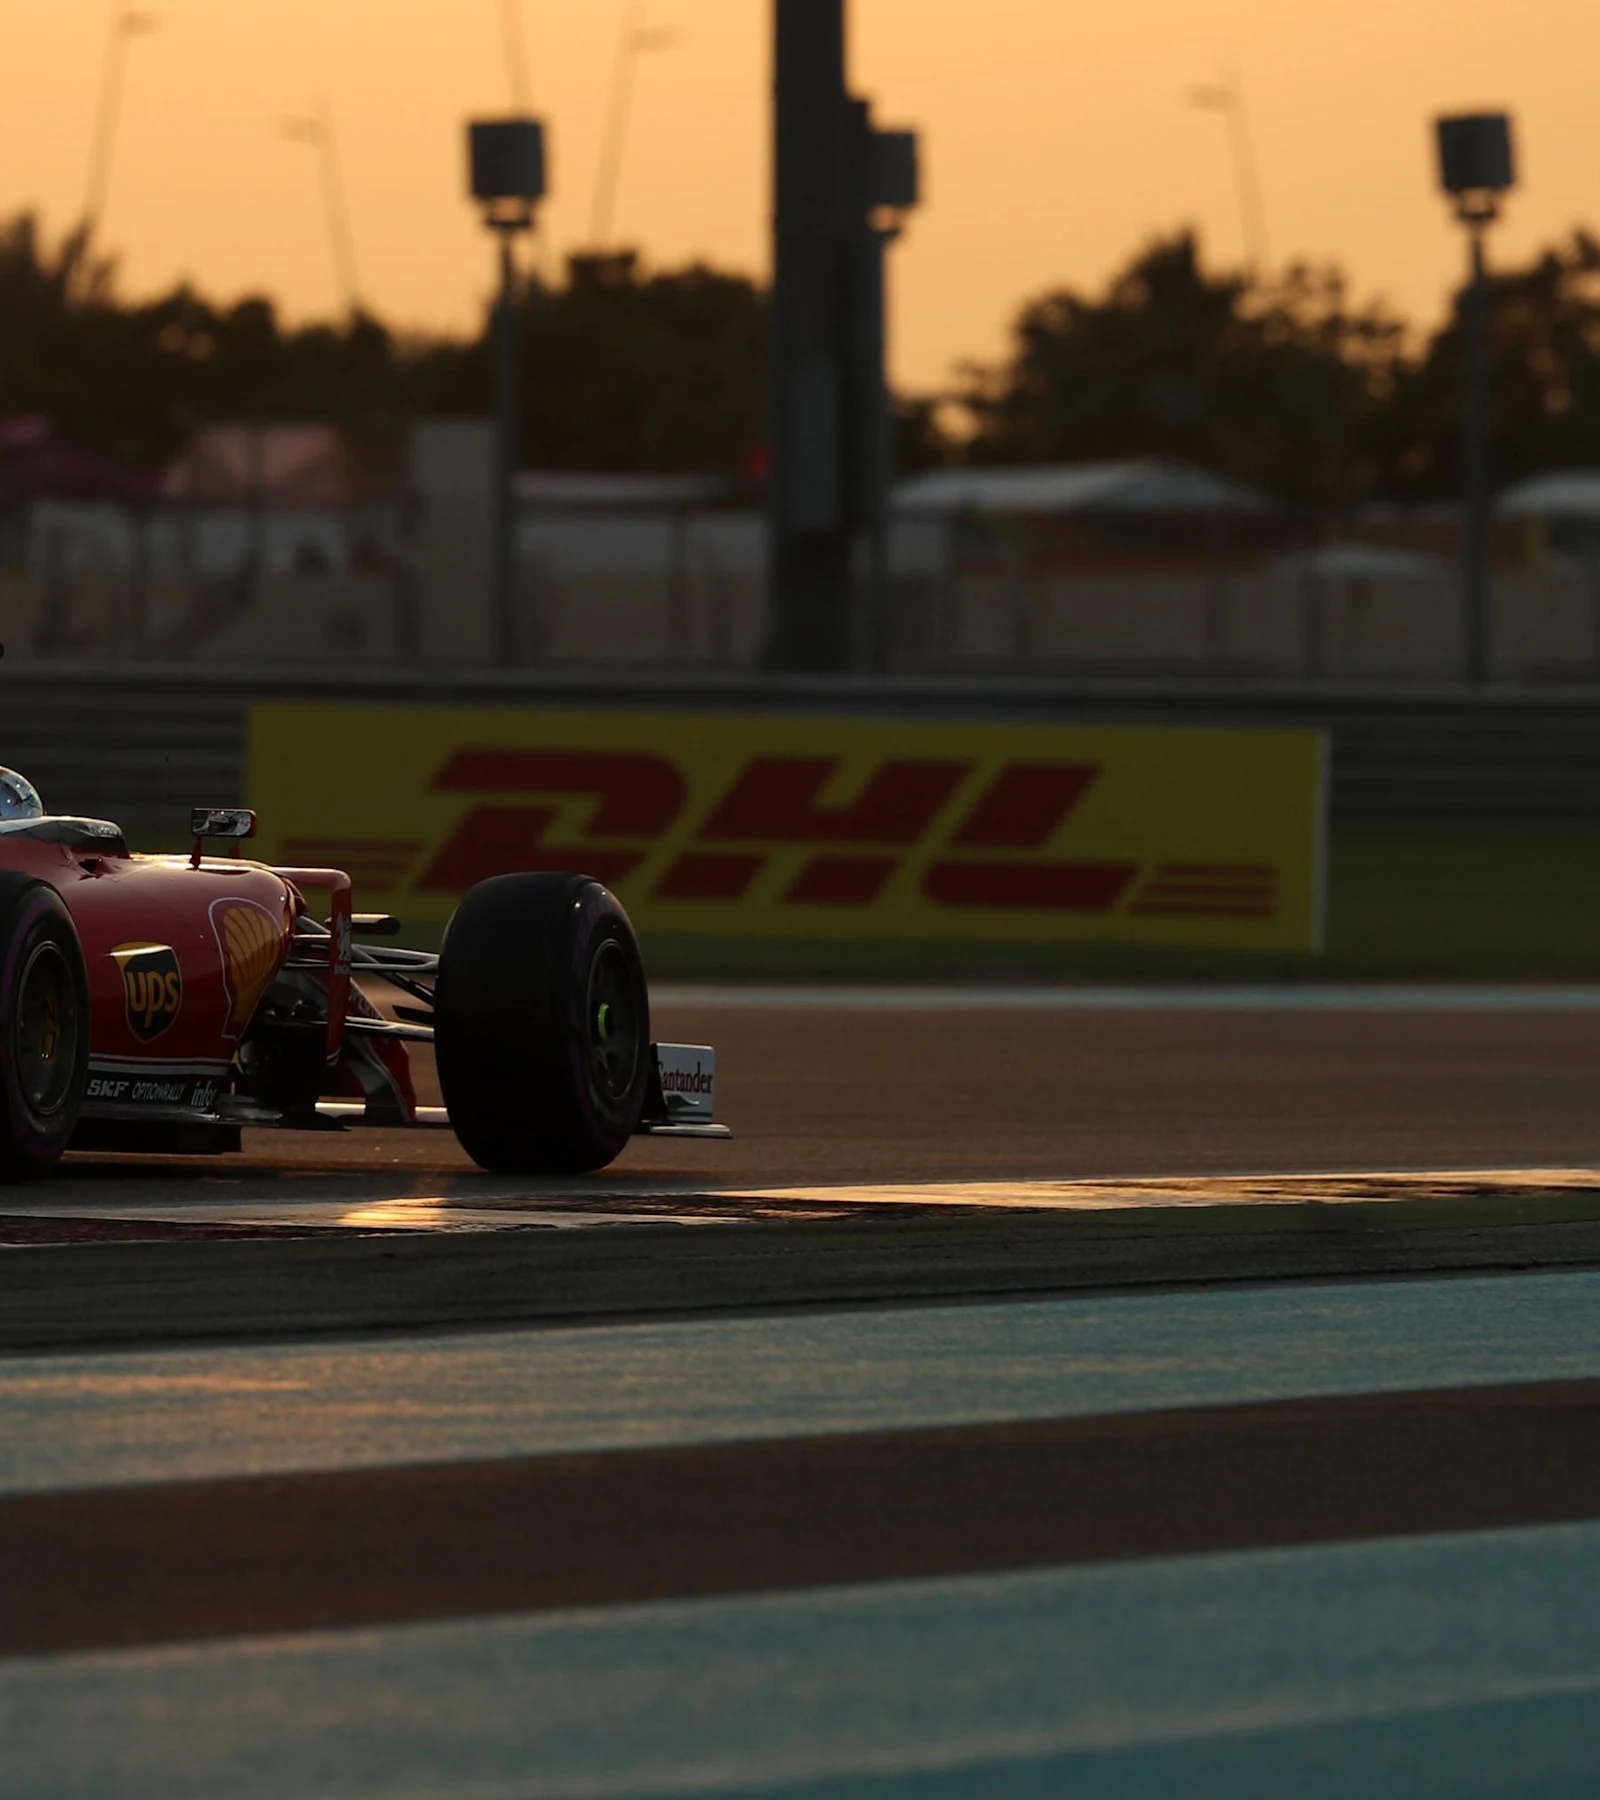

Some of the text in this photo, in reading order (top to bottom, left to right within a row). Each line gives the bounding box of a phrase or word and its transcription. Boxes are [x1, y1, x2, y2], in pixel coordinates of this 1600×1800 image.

[418, 750, 1137, 910] DHL
[126, 971, 180, 1029] ups
[86, 1079, 131, 1098] SKF
